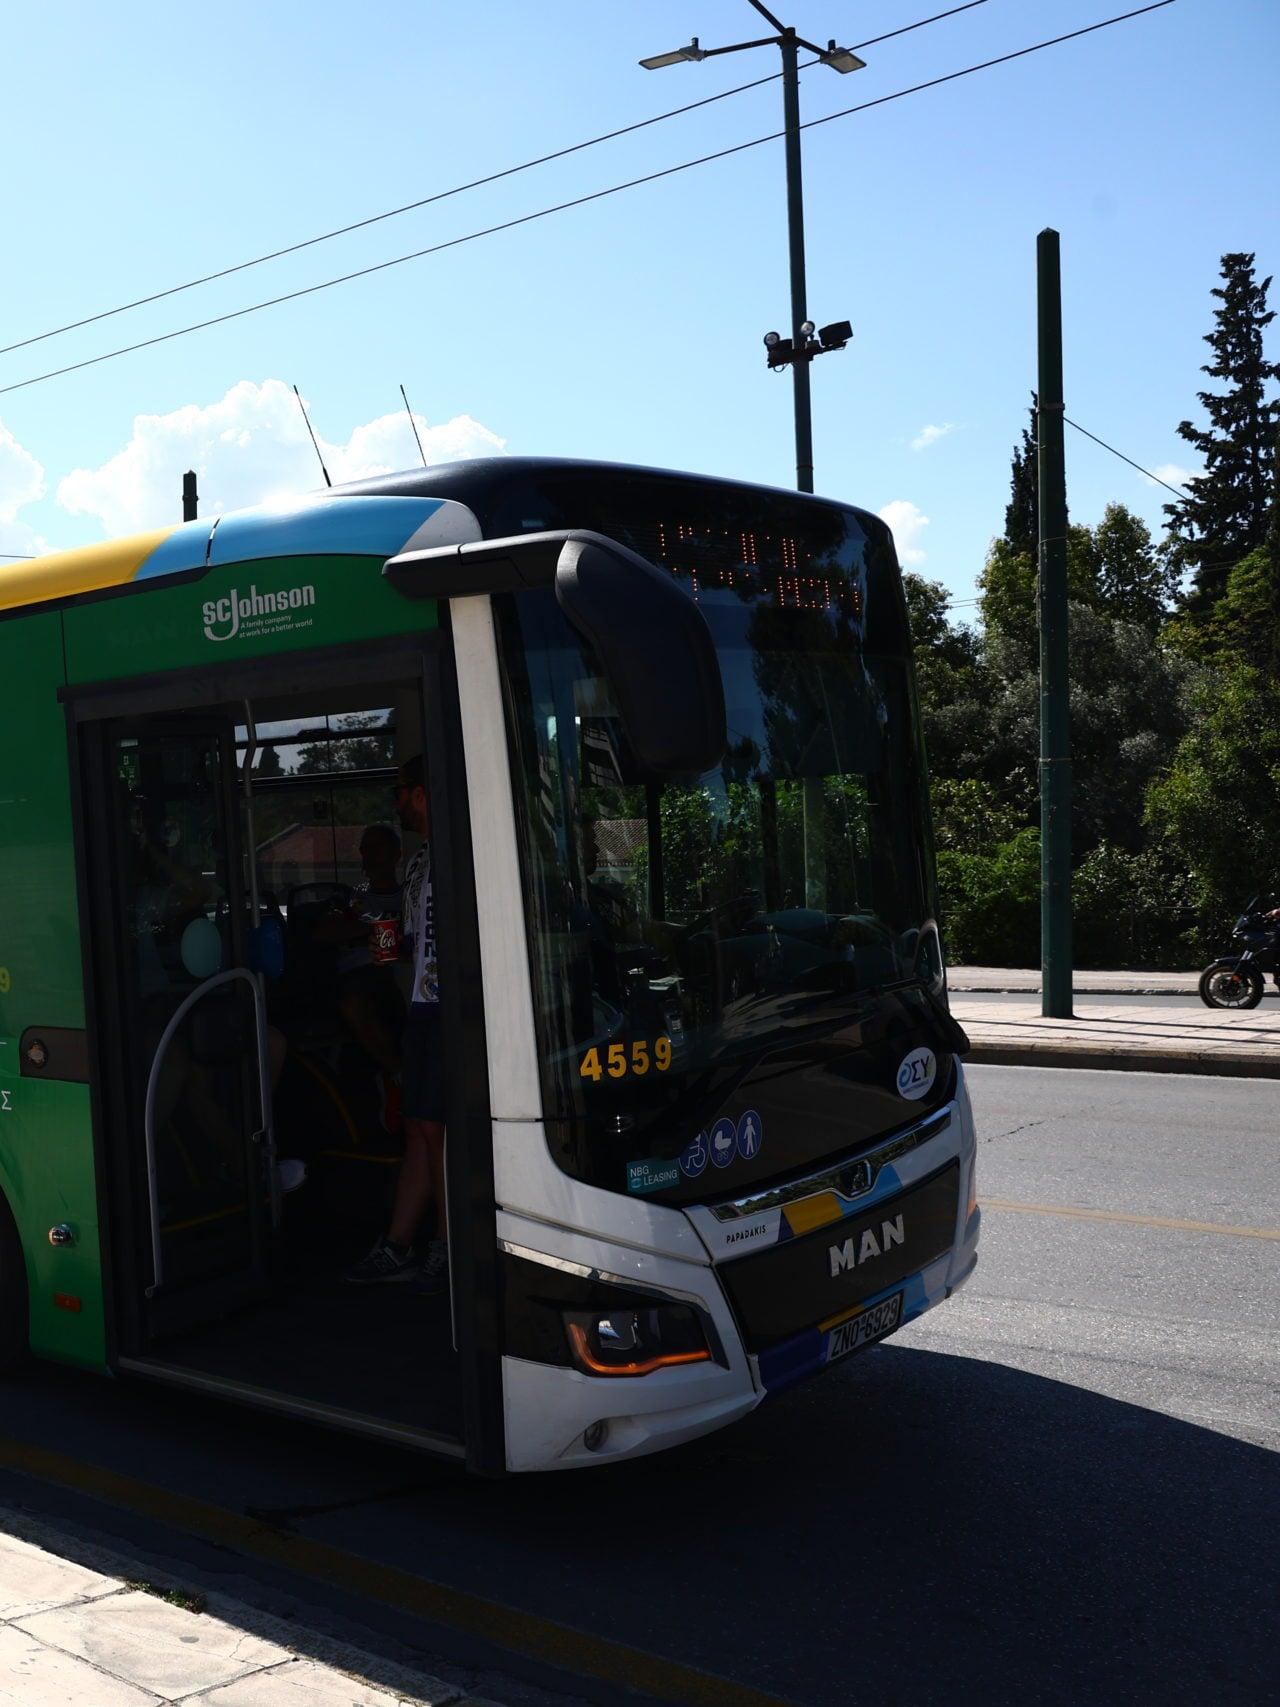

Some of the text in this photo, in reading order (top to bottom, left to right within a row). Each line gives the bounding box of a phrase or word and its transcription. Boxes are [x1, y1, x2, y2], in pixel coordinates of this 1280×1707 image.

[580, 1036, 672, 1082] 4559
[630, 1165, 649, 1178] NBG
[643, 1169, 678, 1186] LEASING
[726, 1225, 767, 1244] PAPADAKIS
[828, 1213, 905, 1278] MAN
